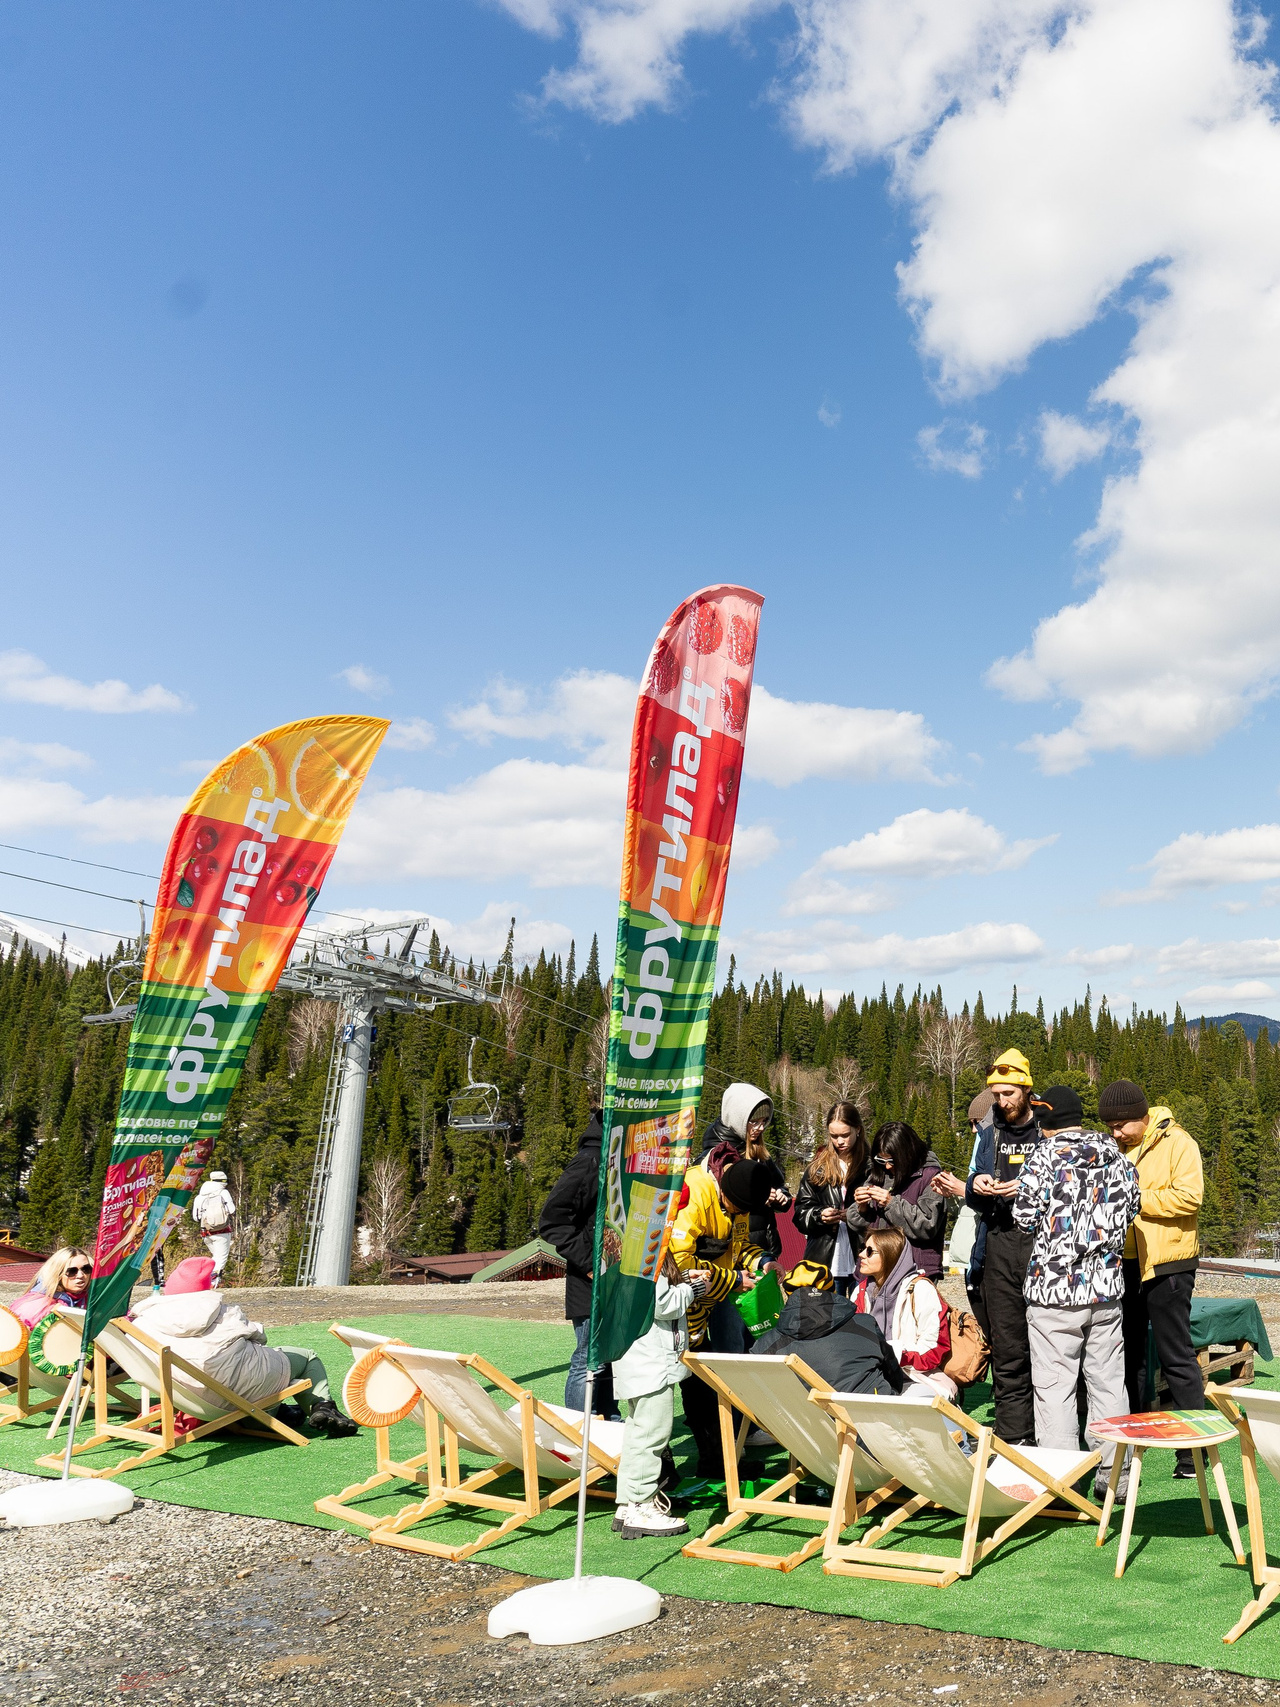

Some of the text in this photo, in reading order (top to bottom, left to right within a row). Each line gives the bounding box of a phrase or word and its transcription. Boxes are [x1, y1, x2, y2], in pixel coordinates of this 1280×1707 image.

[165, 797, 291, 1104] фрутилад
[622, 680, 715, 1059] фрутилад
[344, 1026, 352, 1040] 2
